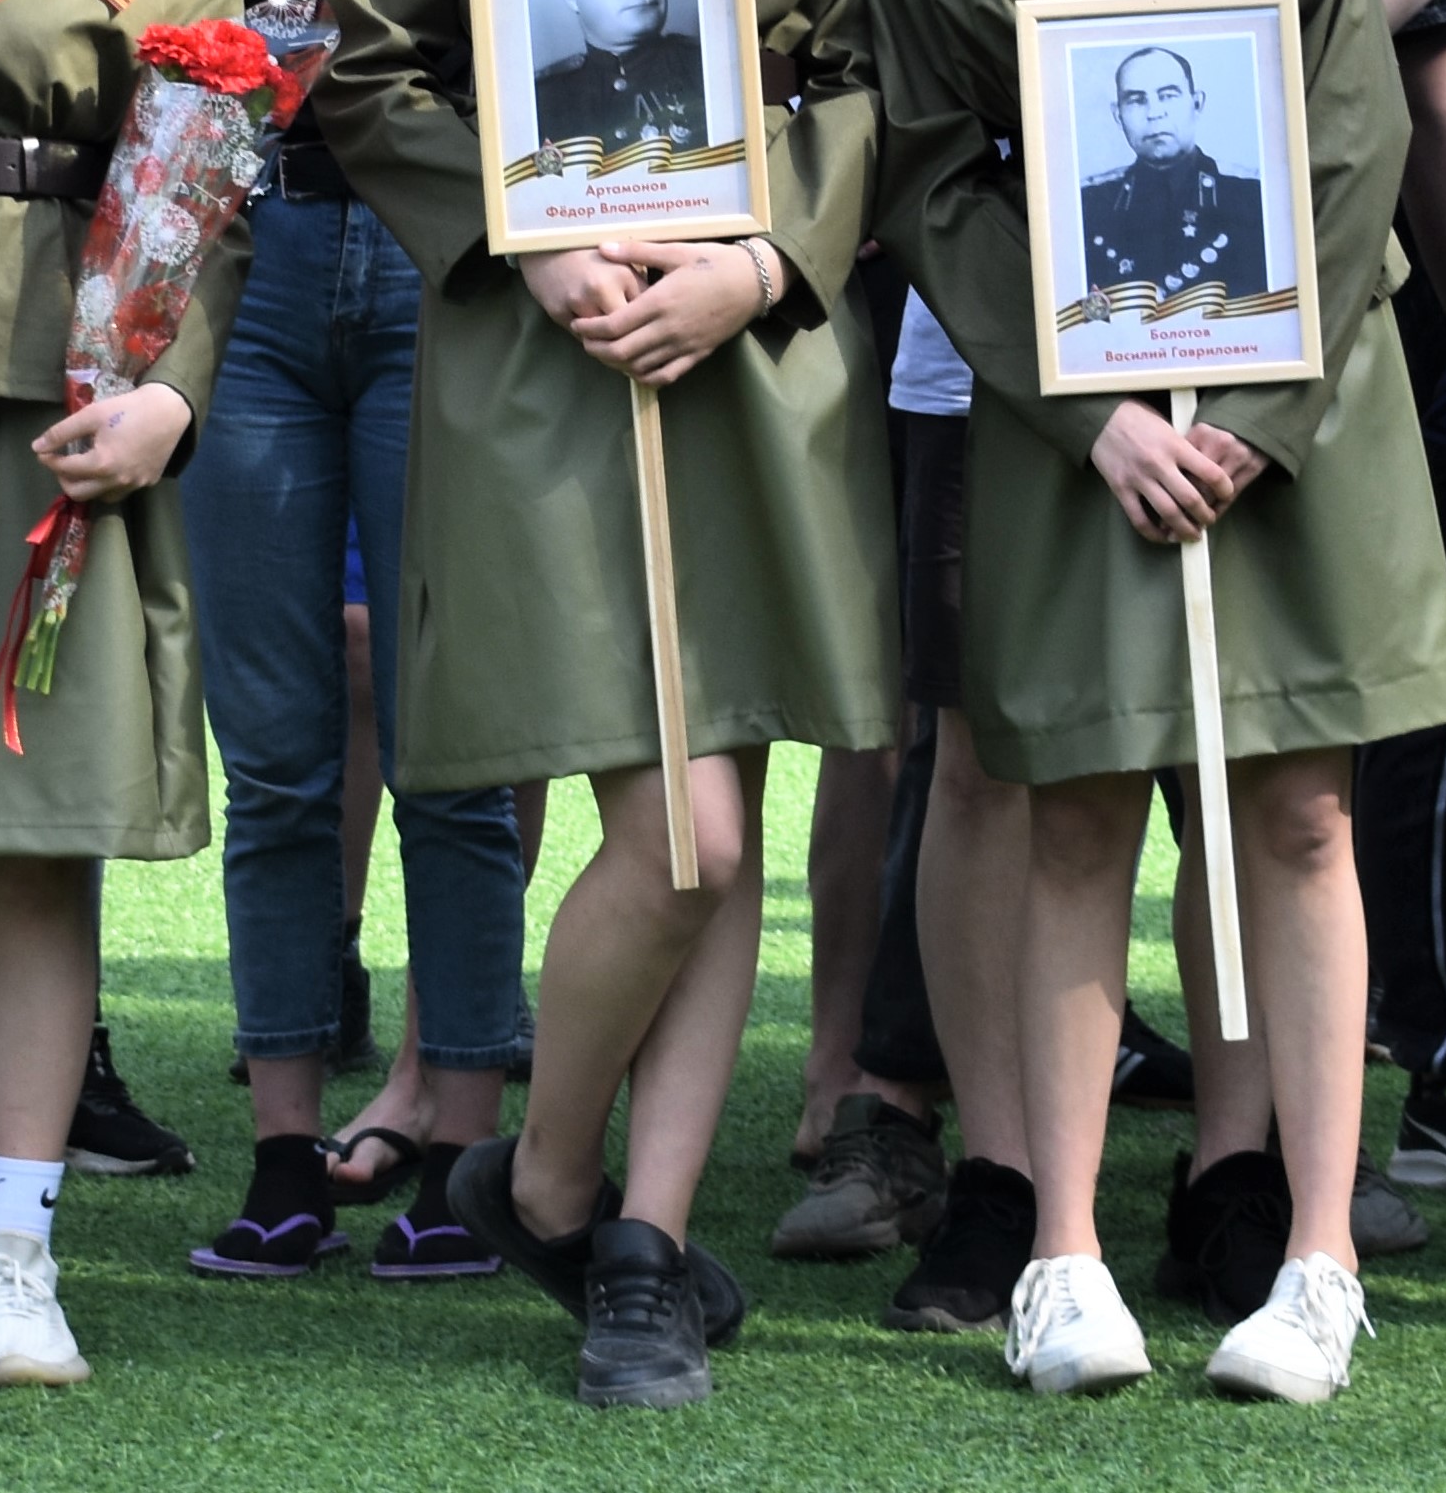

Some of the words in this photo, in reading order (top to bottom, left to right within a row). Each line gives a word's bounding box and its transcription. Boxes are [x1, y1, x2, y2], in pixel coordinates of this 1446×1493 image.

[585, 180, 668, 198] Артамонов
[545, 204, 596, 220] Фёдор
[600, 196, 710, 216] Владимирович
[1149, 327, 1212, 341] Болотов
[1104, 346, 1167, 363] Василий
[1171, 343, 1259, 360] Гаврилович
